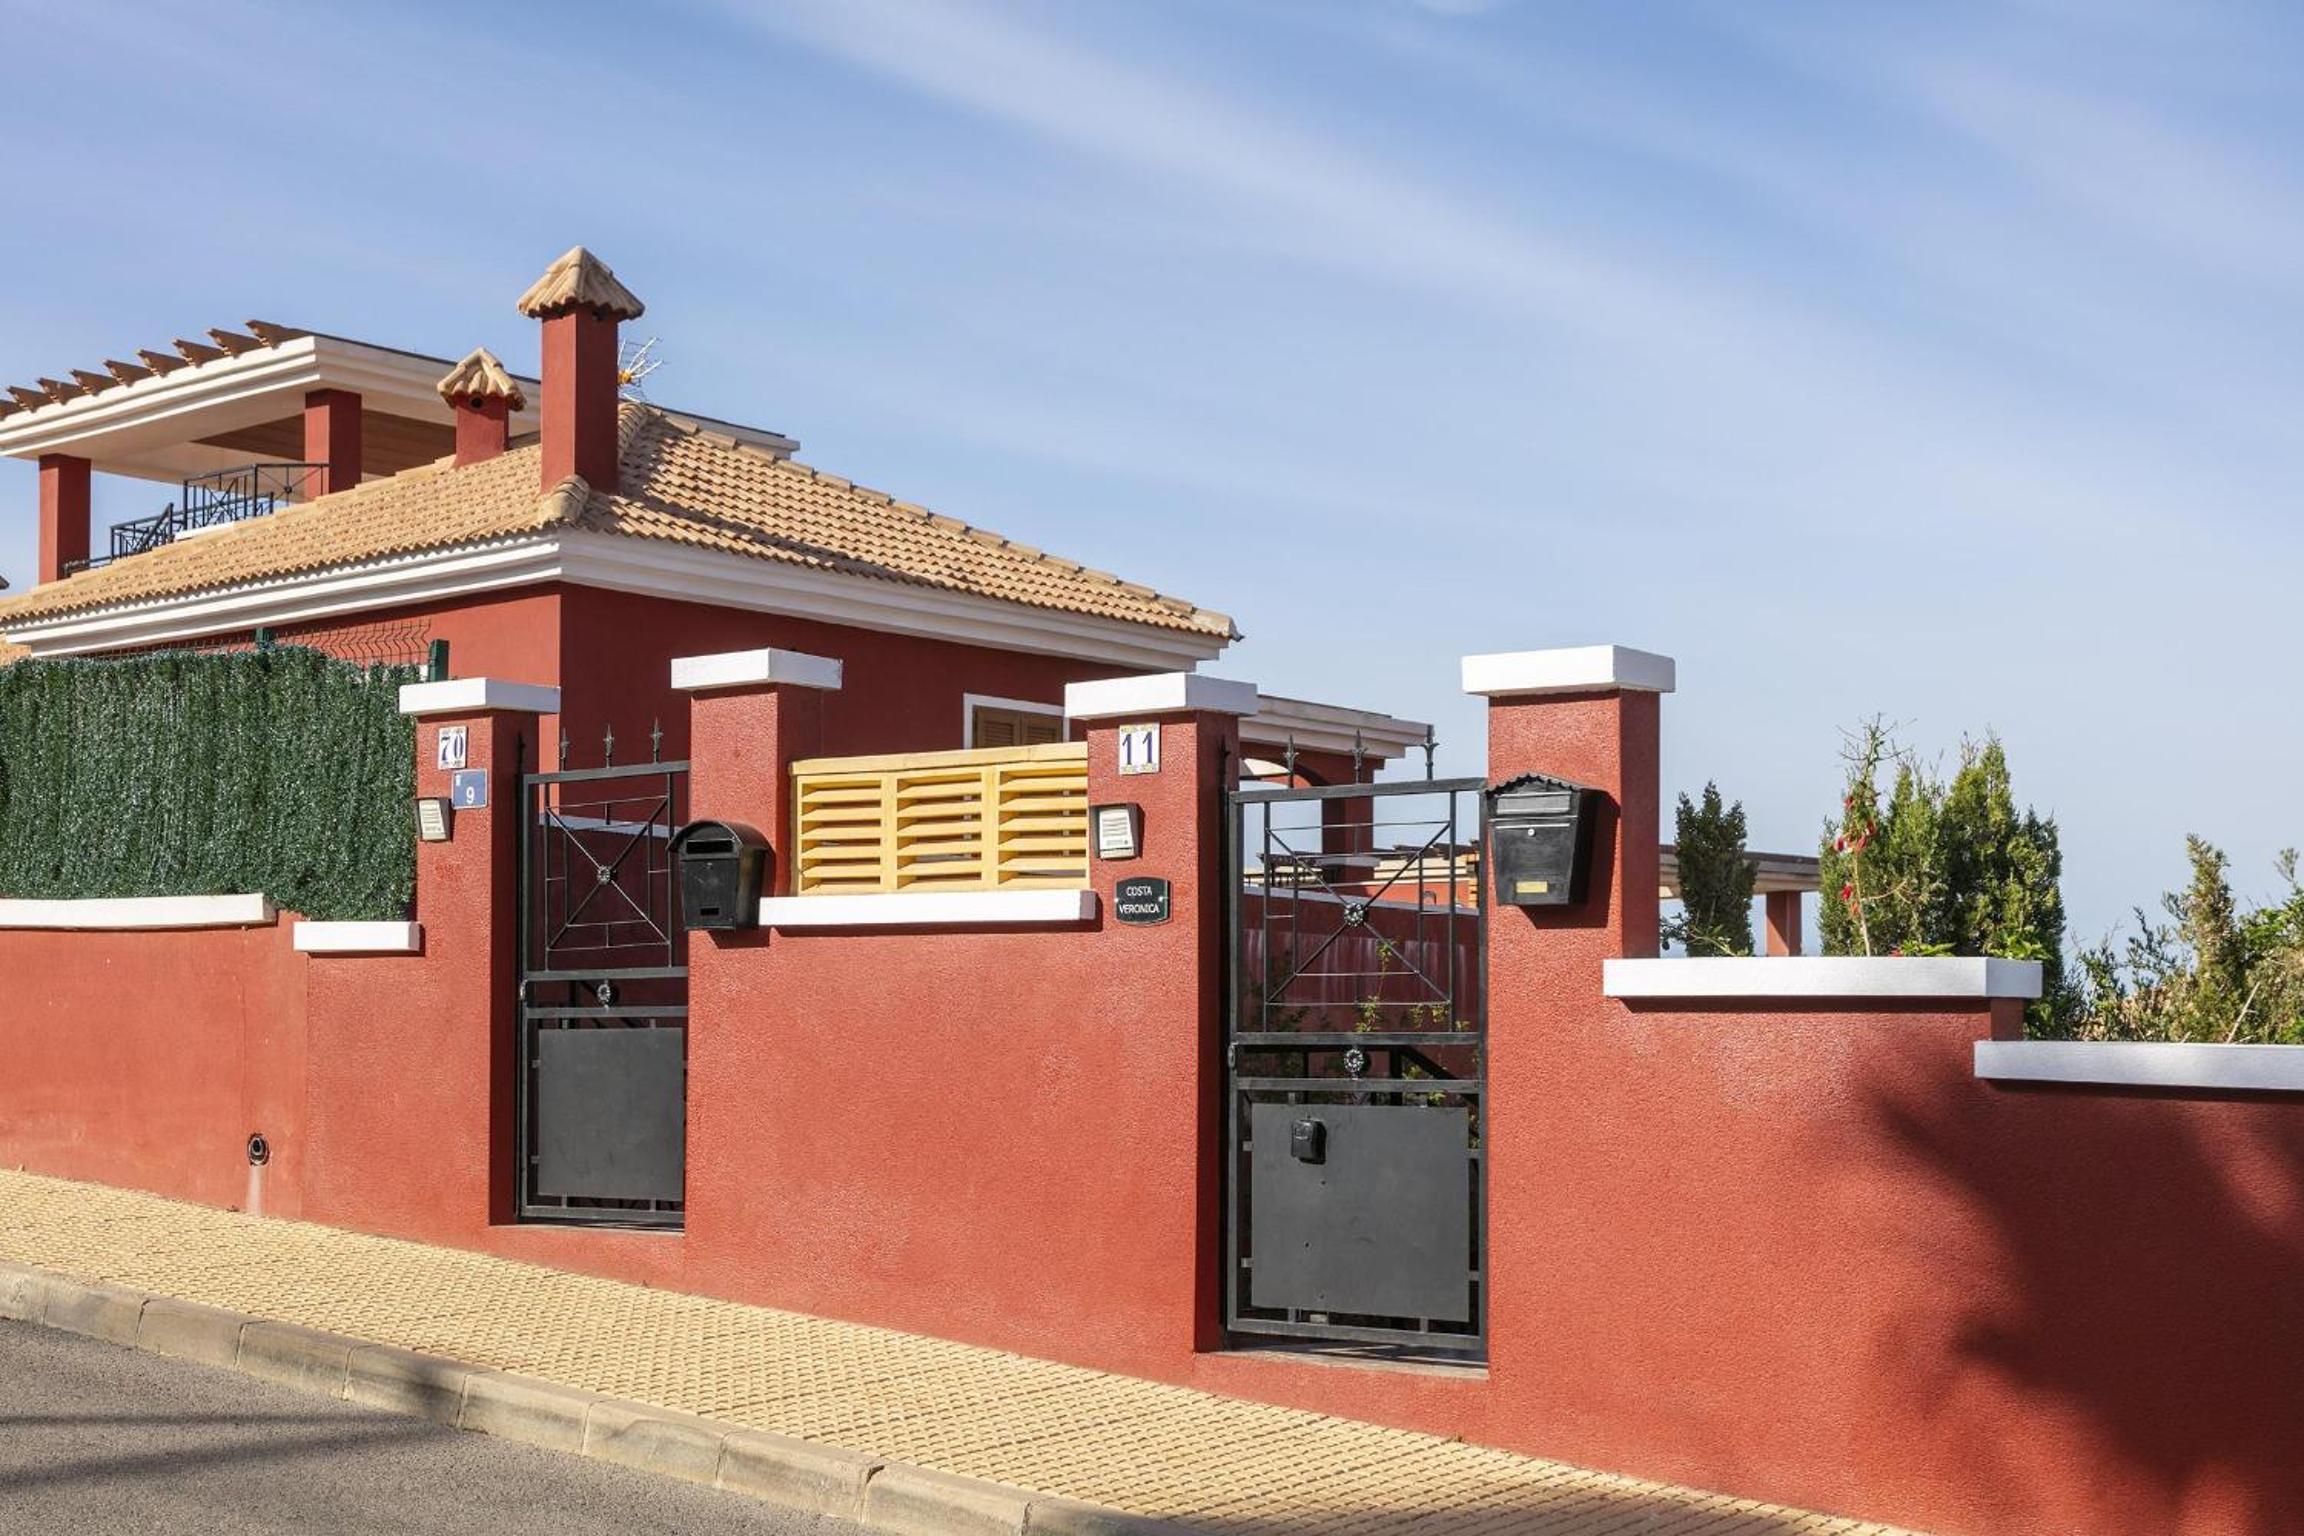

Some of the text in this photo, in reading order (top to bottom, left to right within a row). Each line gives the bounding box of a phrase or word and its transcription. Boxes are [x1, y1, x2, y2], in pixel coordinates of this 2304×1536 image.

[441, 734, 463, 761] 70
[1122, 732, 1152, 765] 11
[466, 786, 475, 804] 9
[1126, 885, 1152, 896] COSTA
[1119, 903, 1160, 914] VERONICA
